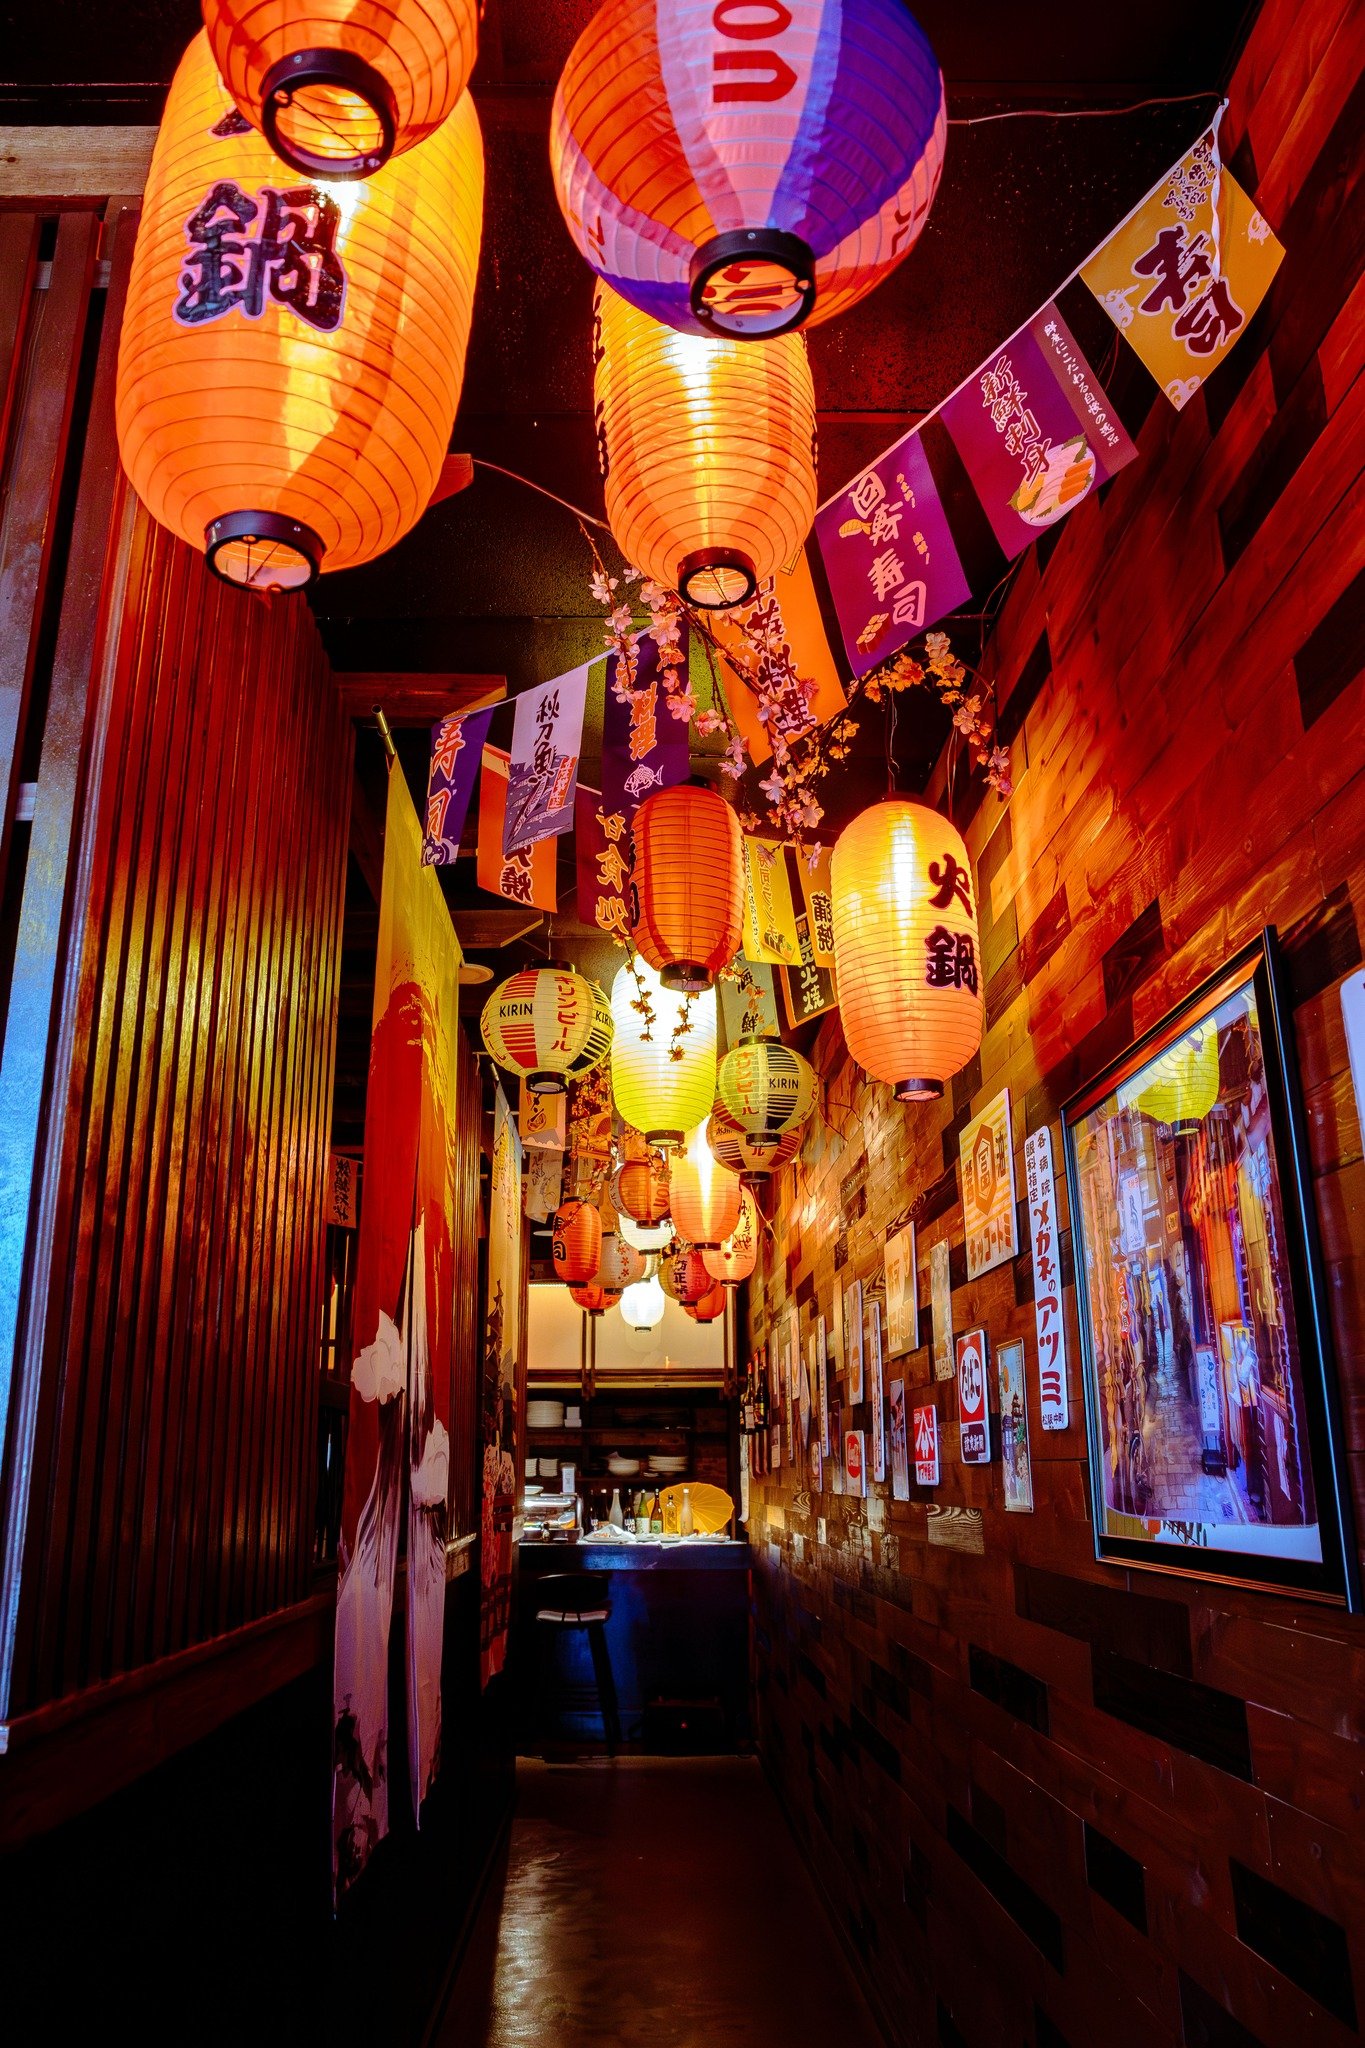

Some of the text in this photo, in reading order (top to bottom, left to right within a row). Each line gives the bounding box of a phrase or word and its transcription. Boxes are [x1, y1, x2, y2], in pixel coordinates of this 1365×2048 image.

[527, 689, 560, 786] 秋刀魚
[426, 715, 470, 844] 寿司
[924, 853, 978, 997] 火鍋
[500, 1003, 533, 1018] KIRIN
[551, 976, 578, 1051] キリンビール
[736, 1051, 760, 1115] キリンビール
[769, 1077, 799, 1090] KIRIN
[1025, 1140, 1039, 1204] 眼科指定
[1038, 1132, 1051, 1197] 各病院
[1034, 1200, 1062, 1406] メガネのアツミ
[961, 1354, 981, 1400] たばこ
